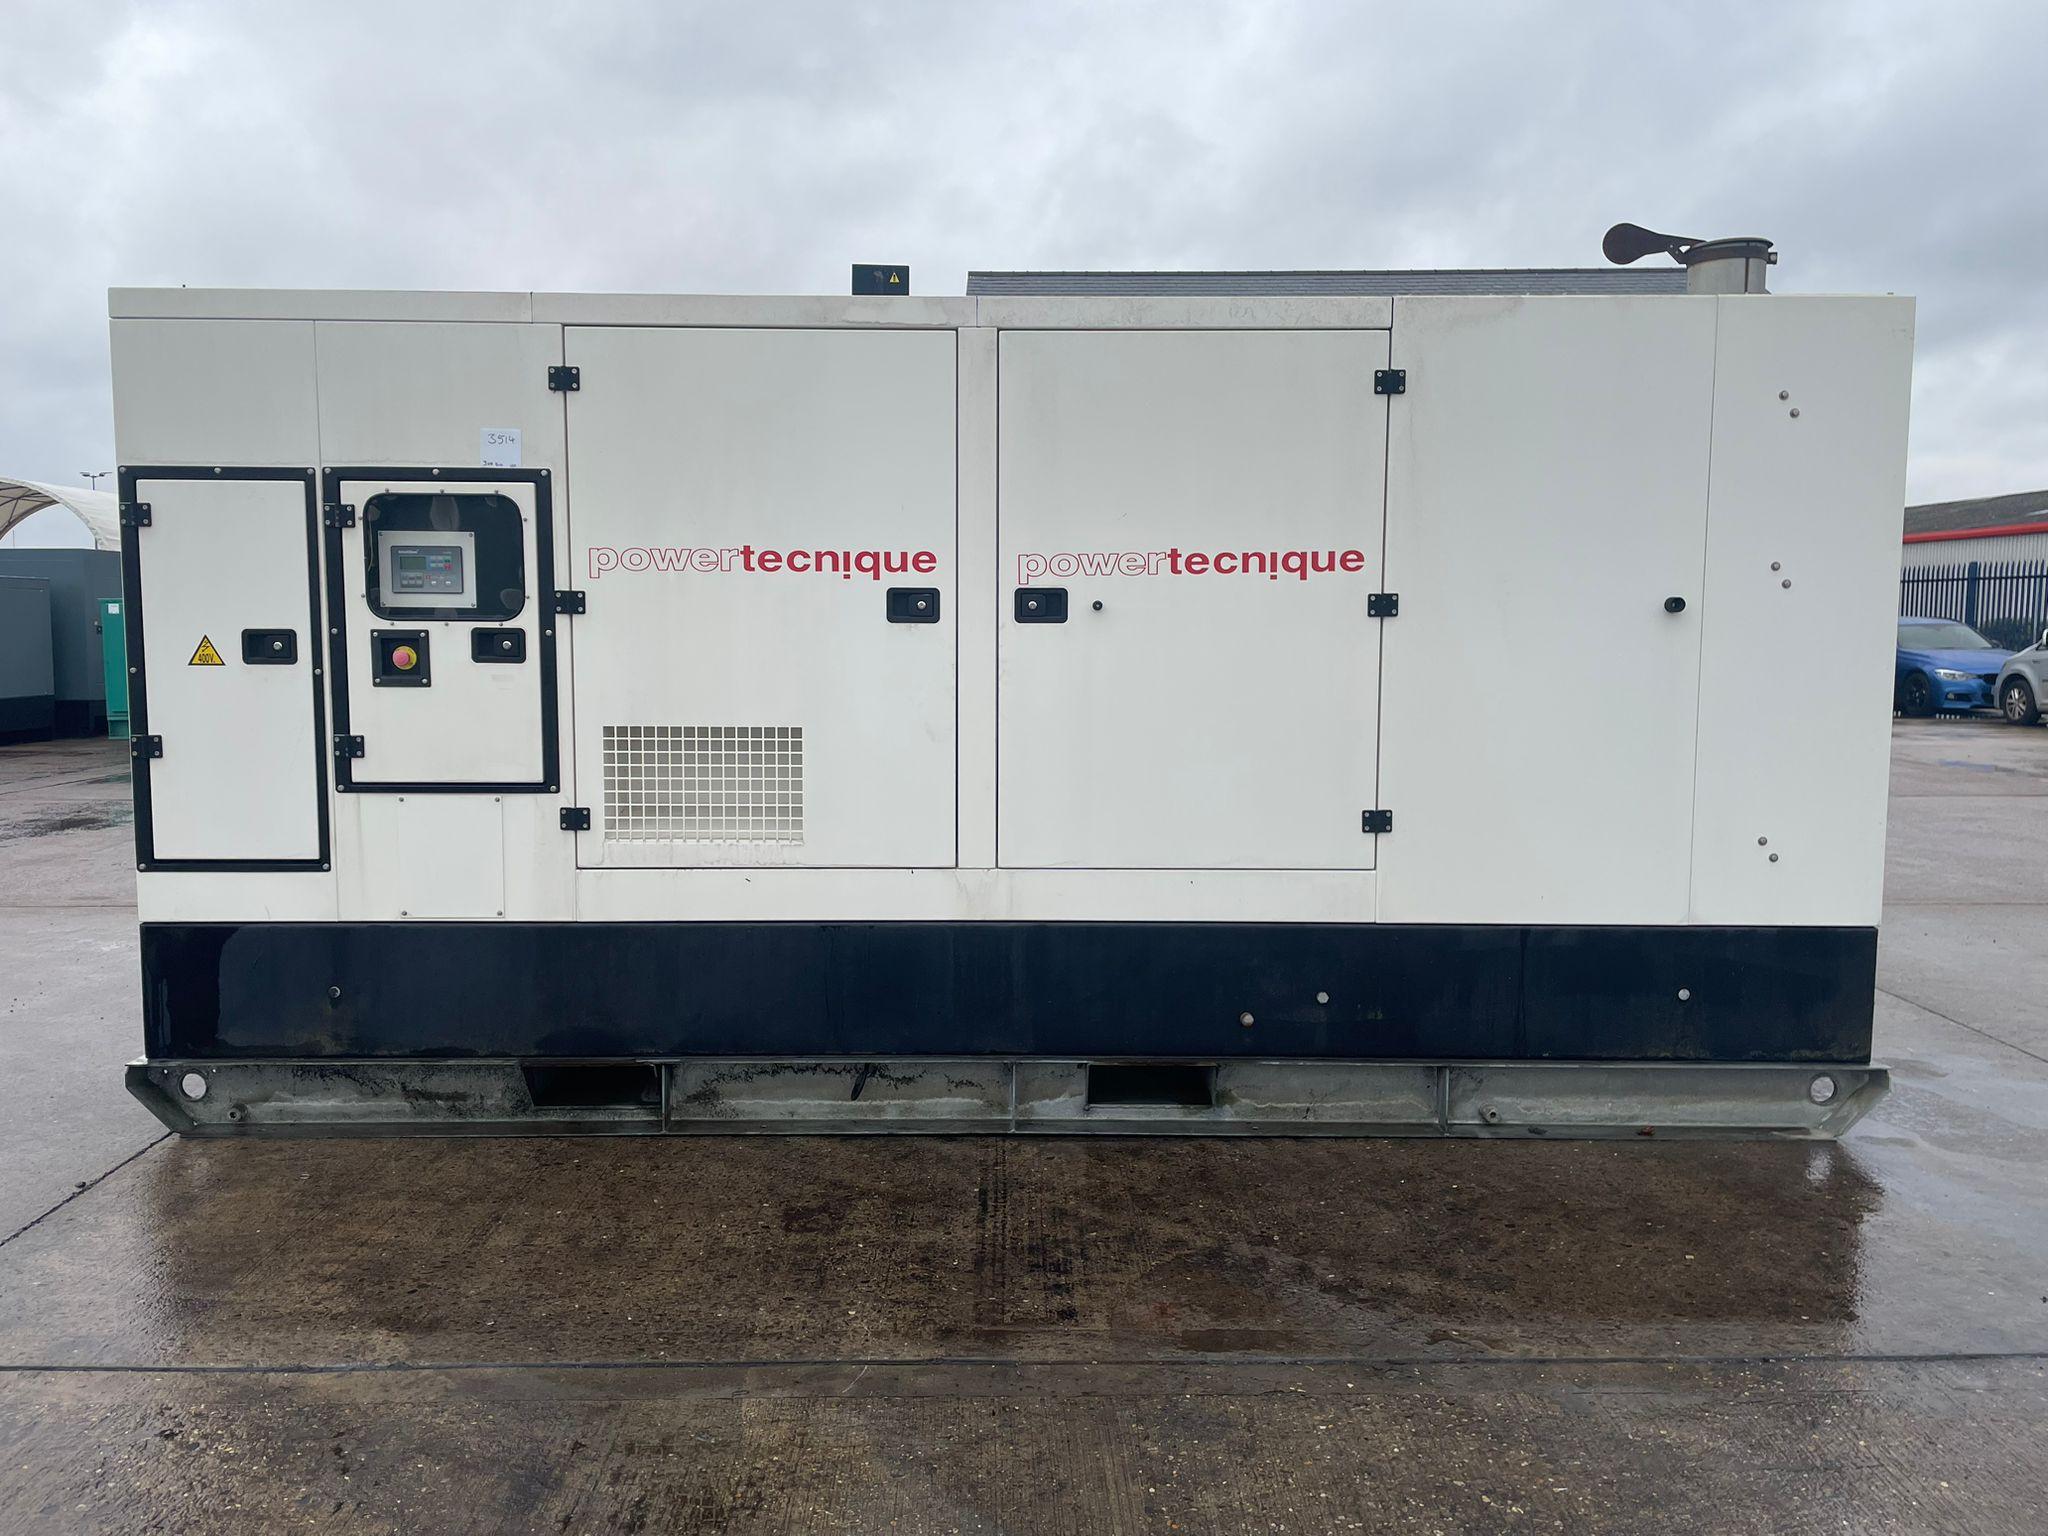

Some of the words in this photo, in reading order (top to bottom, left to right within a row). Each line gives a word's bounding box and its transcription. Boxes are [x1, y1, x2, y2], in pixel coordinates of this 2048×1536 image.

[487, 432, 516, 445] 3514
[588, 545, 938, 580] powertecnique
[1017, 548, 1365, 585] powertecnique
